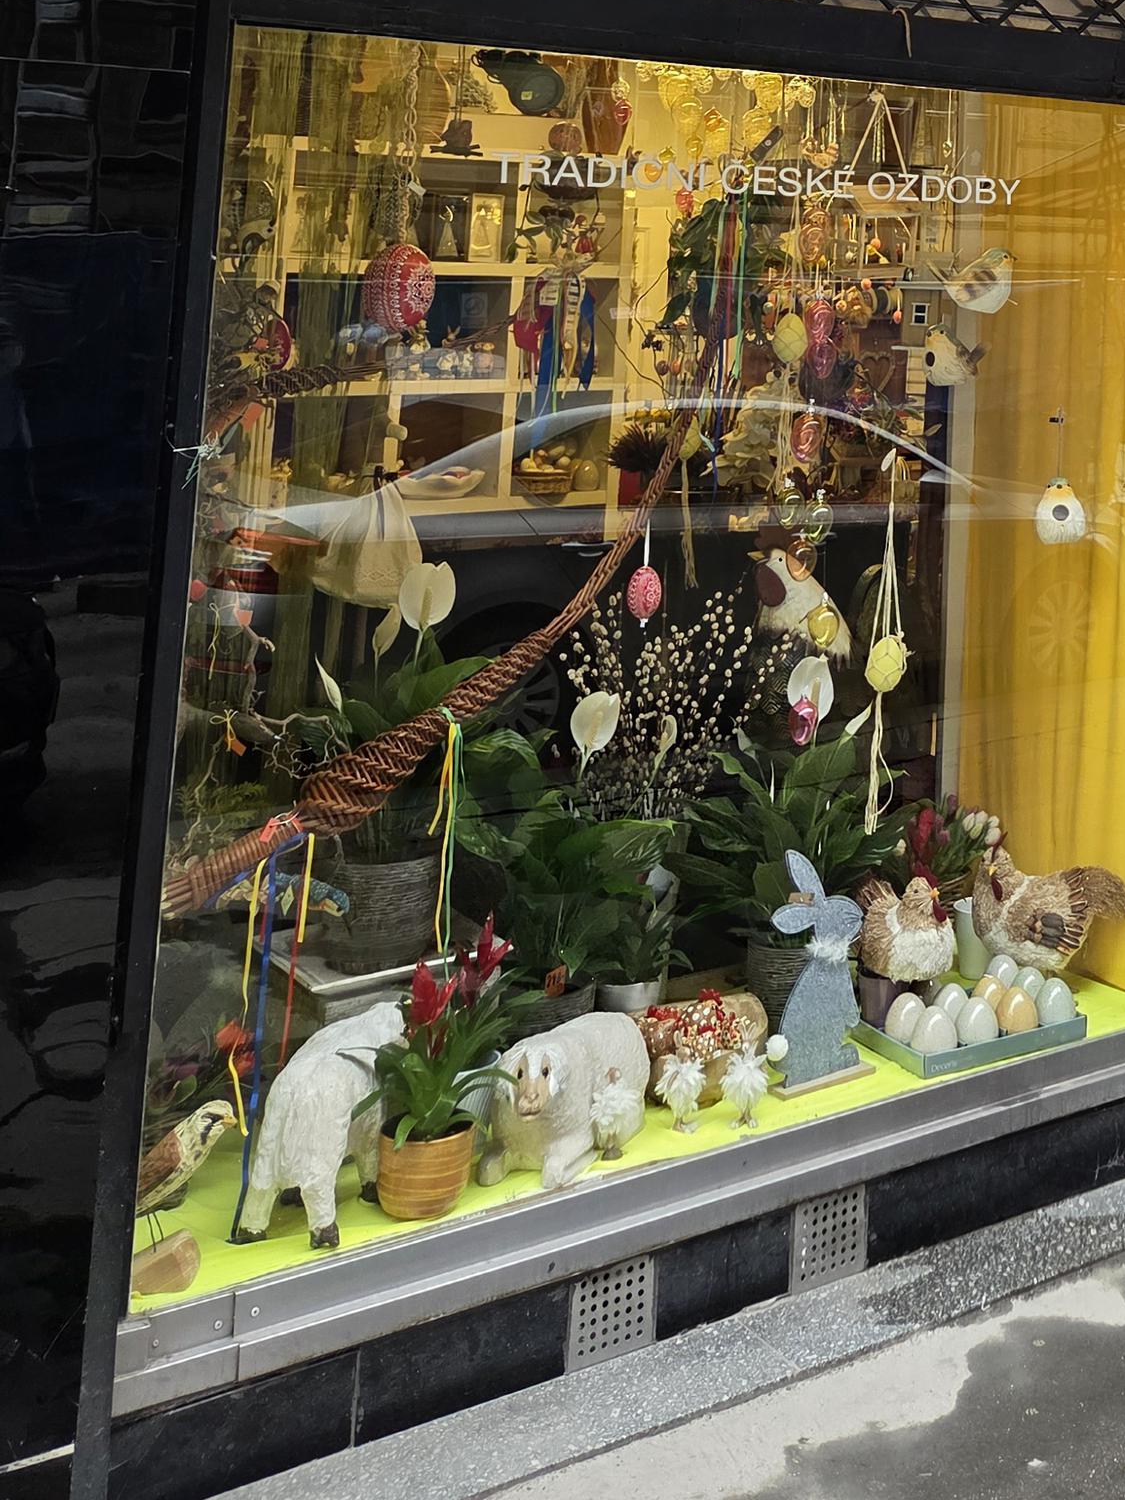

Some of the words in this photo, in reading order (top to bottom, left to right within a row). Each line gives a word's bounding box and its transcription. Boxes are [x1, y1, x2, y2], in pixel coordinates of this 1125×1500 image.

[491, 151, 707, 192] TRADIČNÍ
[722, 158, 854, 198] ČESKÉ
[867, 171, 1021, 205] OZDOBY
